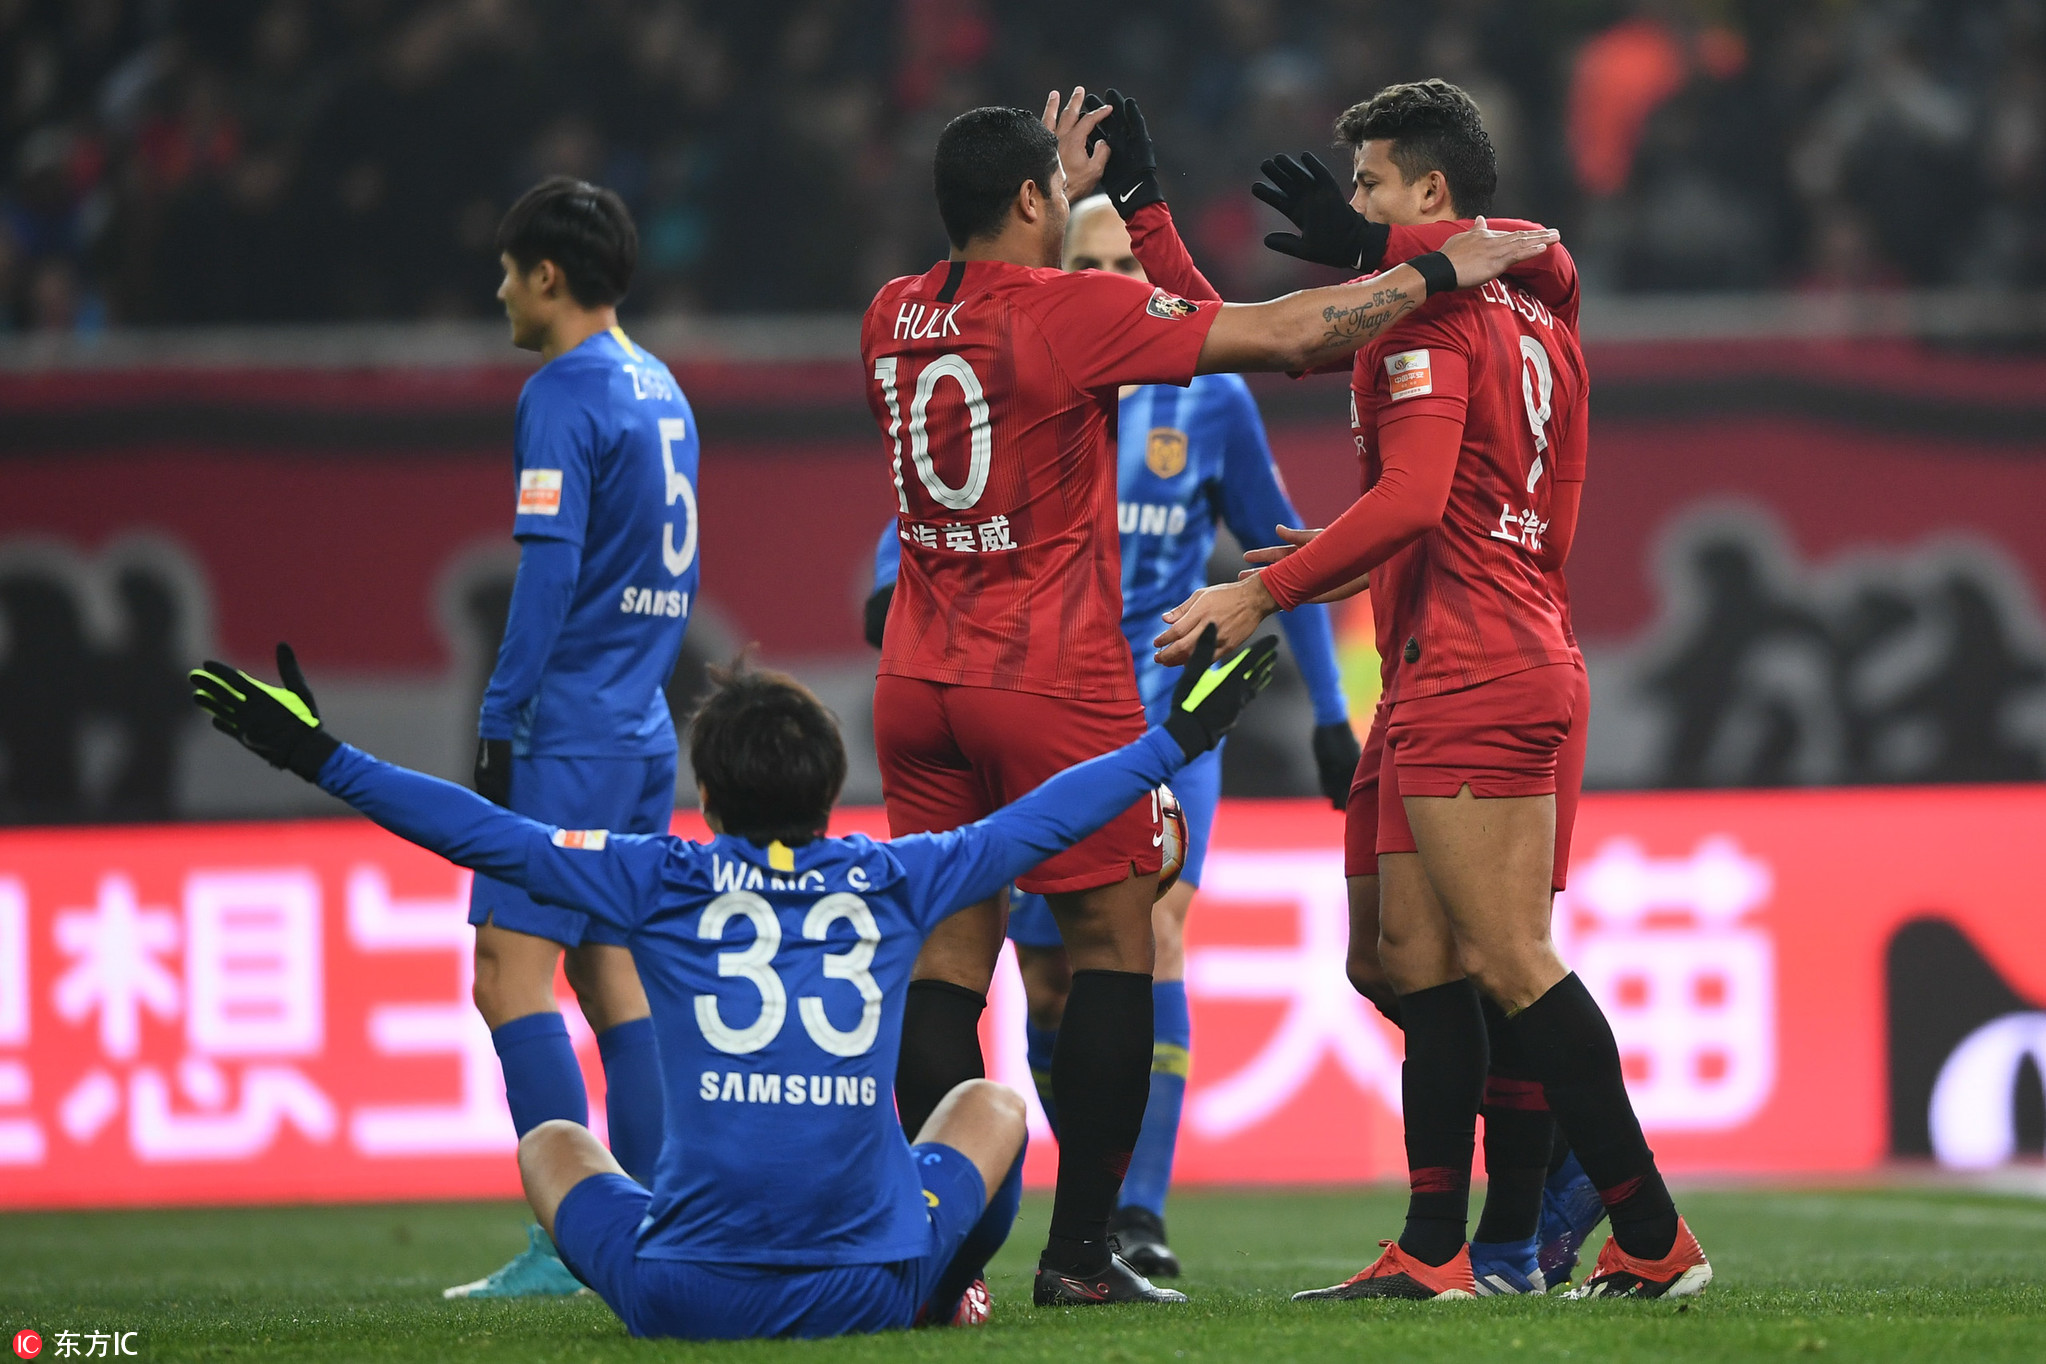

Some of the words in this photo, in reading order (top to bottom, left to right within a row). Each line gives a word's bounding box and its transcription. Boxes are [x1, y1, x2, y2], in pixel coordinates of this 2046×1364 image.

[893, 300, 966, 340] HULK
[1344, 302, 1392, 337] Tiago
[873, 353, 993, 514] 10
[1519, 334, 1553, 494] 9
[657, 417, 698, 577] 5
[693, 890, 884, 1058] 33
[699, 1070, 878, 1108] SAMSUNG
